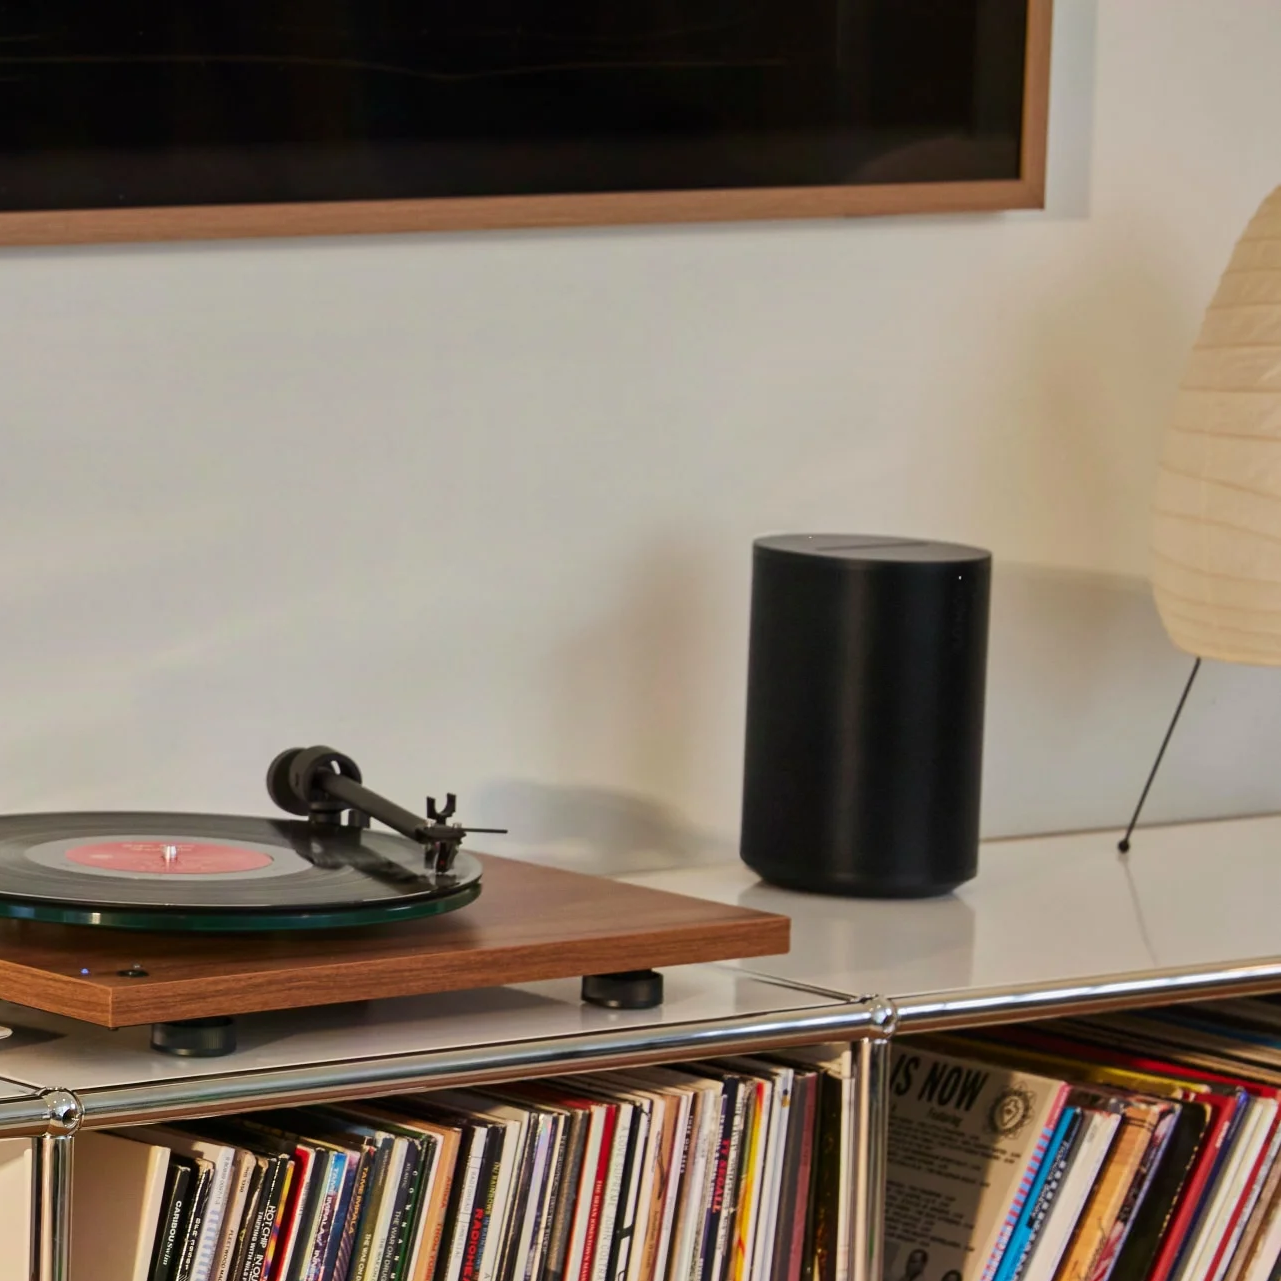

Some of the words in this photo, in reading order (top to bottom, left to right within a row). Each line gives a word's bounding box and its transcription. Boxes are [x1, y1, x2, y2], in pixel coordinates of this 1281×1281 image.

[918, 1062, 988, 1112] NOW
[616, 1135, 628, 1158] LOVE
[719, 1138, 731, 1155] TY
[326, 1166, 339, 1195] TAME
[357, 1165, 369, 1195] TAME
[400, 1161, 412, 1189] ATLANTIC
[594, 1179, 602, 1194] THE
[607, 1162, 623, 1207] SUPREME
[710, 1159, 729, 1214] SEGALL
[439, 1175, 452, 1209] ANIMA
[463, 1170, 478, 1212] RADIOHEAD
[483, 1174, 498, 1215] RAINBOWS
[263, 1204, 276, 1228] HOT
[317, 1195, 333, 1235] IMPALA
[347, 1194, 362, 1235] IMPALA
[391, 1209, 402, 1226] THE
[590, 1194, 600, 1217] BRIAN
[166, 1199, 183, 1243] CARIBOU
[250, 1210, 264, 1242] TRIPPING
[602, 1215, 615, 1241] JOHN
[258, 1225, 271, 1249] CHIP
[362, 1232, 372, 1246] THE
[387, 1225, 399, 1245] WAR
[430, 1221, 442, 1252] THOM
[582, 1217, 596, 1261] JONESTOWN
[161, 1241, 173, 1267] Swim
[219, 1228, 234, 1269] FLEETWOOD
[246, 1241, 256, 1260] WITH
[254, 1253, 264, 1265] IN
[359, 1246, 368, 1262] WAR
[384, 1244, 394, 1259] ON
[242, 1259, 251, 1277] NILS
[356, 1262, 365, 1275] ON
[482, 1271, 490, 1280] A
